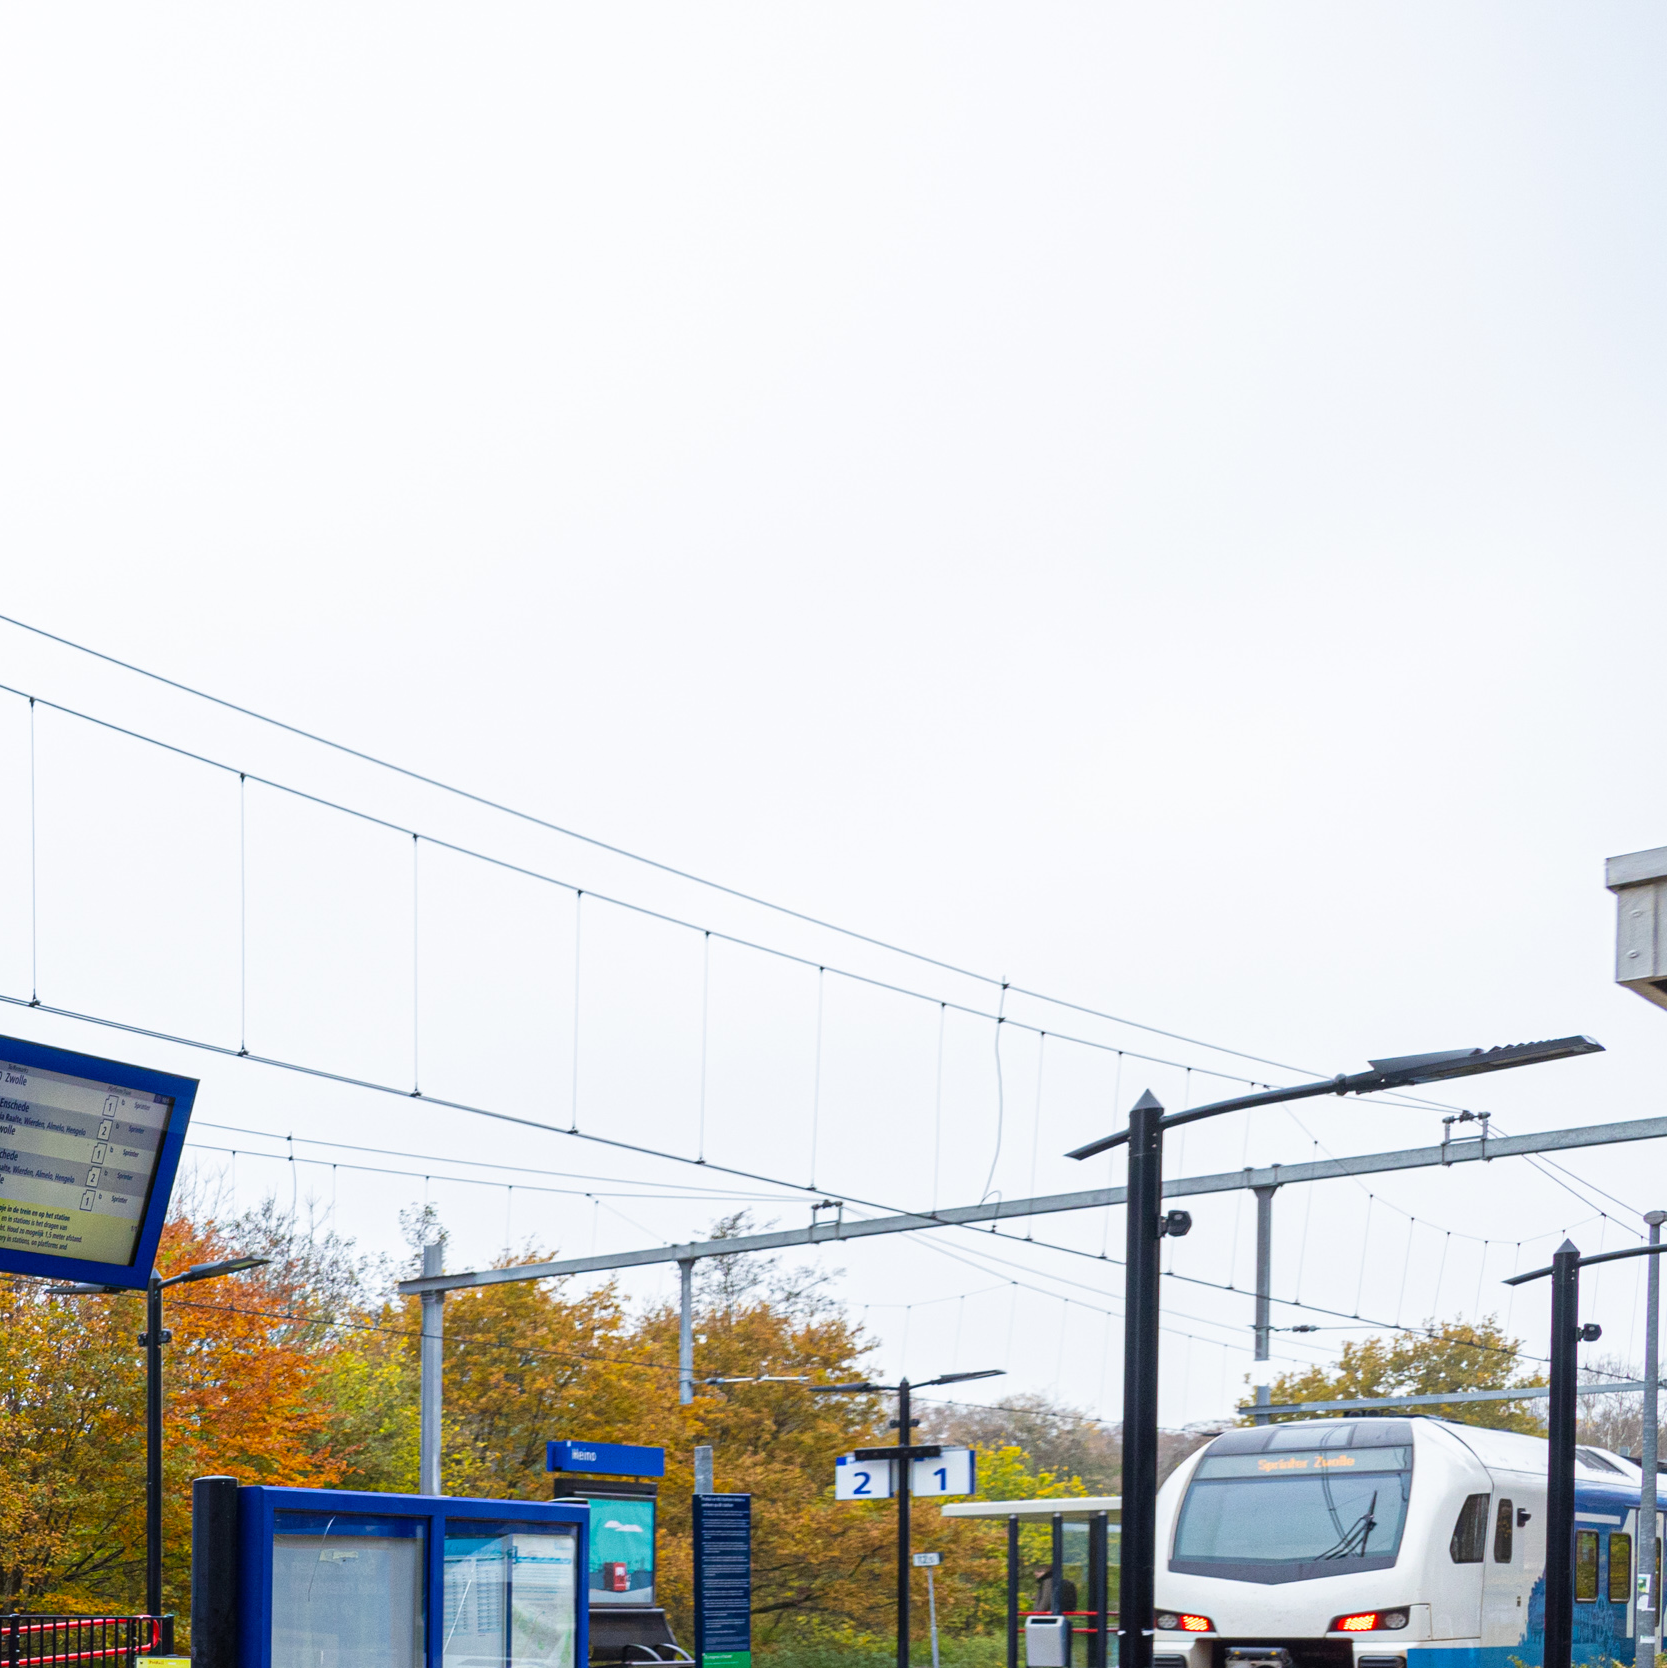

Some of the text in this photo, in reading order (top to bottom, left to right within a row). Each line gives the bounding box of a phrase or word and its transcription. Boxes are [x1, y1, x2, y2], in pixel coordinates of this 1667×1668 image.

[5, 1073, 28, 1086] Zwolle
[108, 1102, 113, 1112] 1
[134, 1102, 151, 1111] Sprinter
[0, 1098, 30, 1112] Enschede
[101, 1126, 107, 1136] 2
[128, 1125, 145, 1134] Sprinter
[66, 1124, 86, 1137] Hengelo
[123, 1149, 139, 1158] Sprinter
[55, 1172, 75, 1184] Hengelo
[90, 1173, 96, 1183] 2
[117, 1172, 133, 1181] Sprinter
[111, 1195, 128, 1205] Sprinter
[20, 1207, 32, 1215] trein
[54, 1213, 70, 1221] station
[13, 1216, 30, 1225] stations
[44, 1221, 59, 1231] dragen
[7, 1225, 18, 1233] Houd
[25, 1227, 44, 1238] mogelijk
[37, 1240, 58, 1249] platforms
[1258, 1455, 1356, 1472] Sprinter Zwolle
[853, 1471, 872, 1495] 2
[933, 1467, 947, 1491] 1
